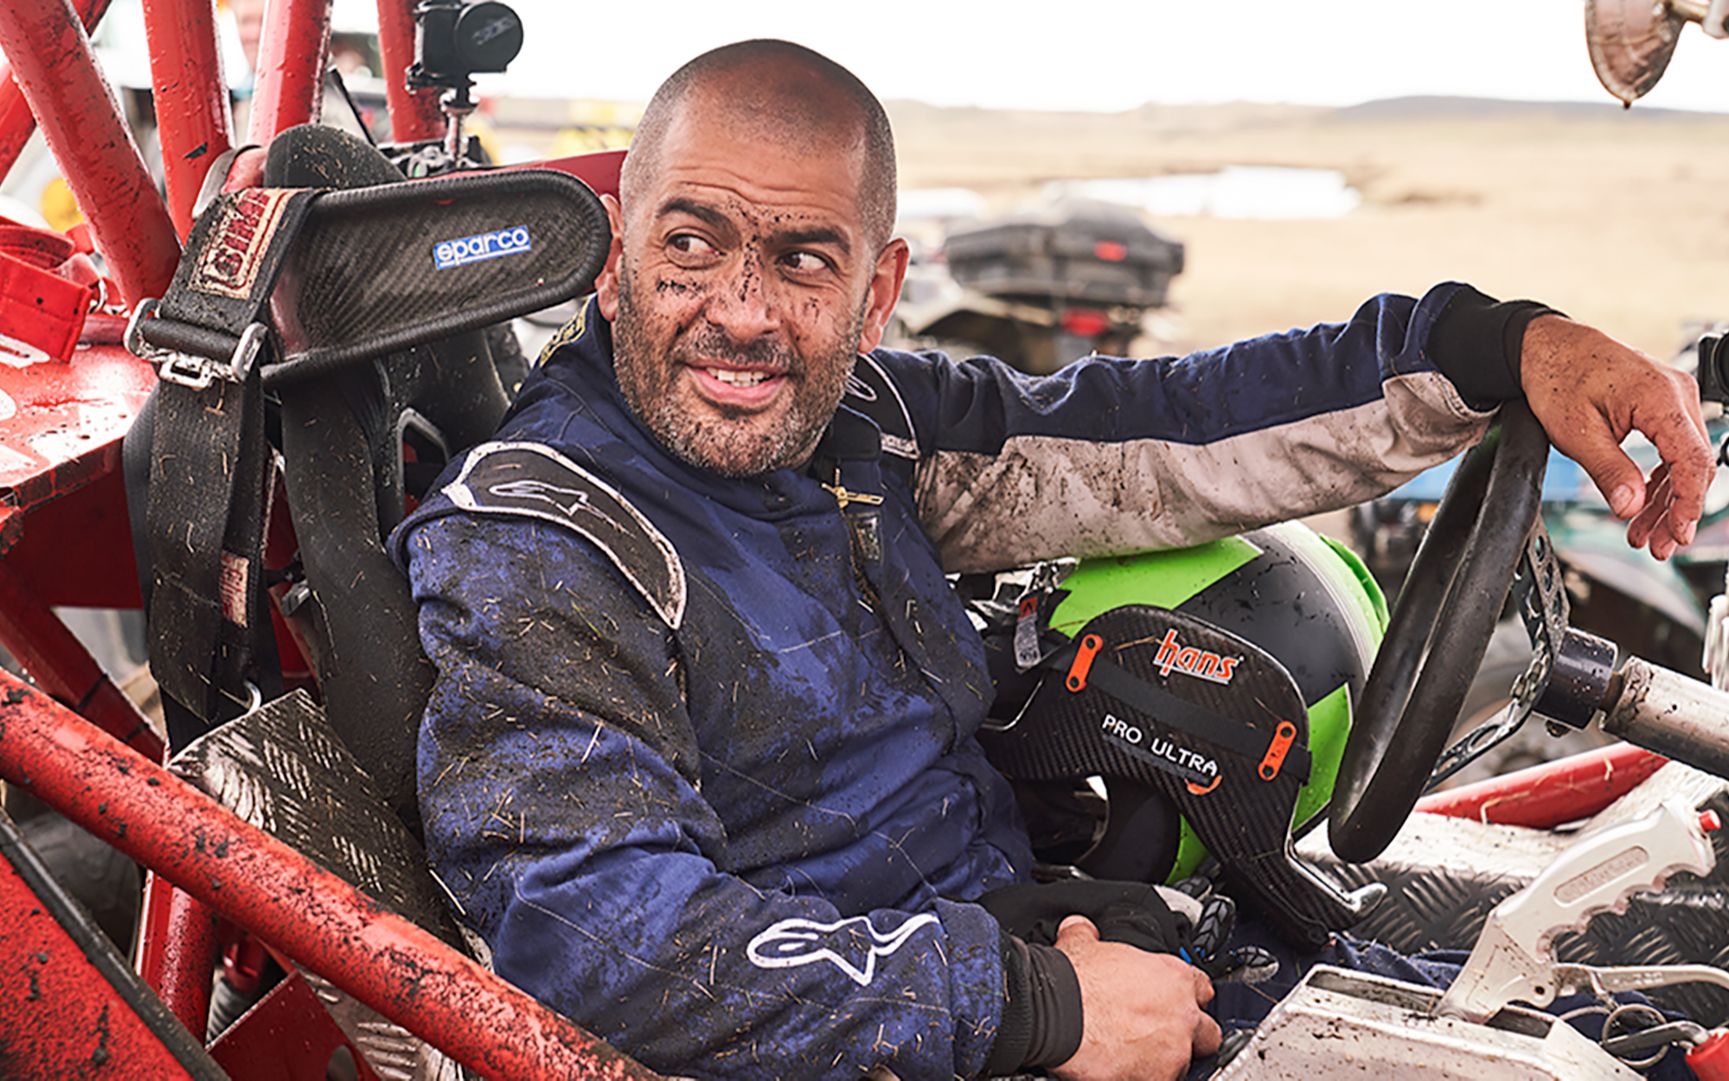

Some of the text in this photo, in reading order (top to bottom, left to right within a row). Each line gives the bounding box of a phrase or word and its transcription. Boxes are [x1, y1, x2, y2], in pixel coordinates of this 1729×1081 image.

[437, 228, 529, 267] sparco
[1153, 628, 1240, 684] hans
[1102, 714, 1219, 777] PRO ULTRA
